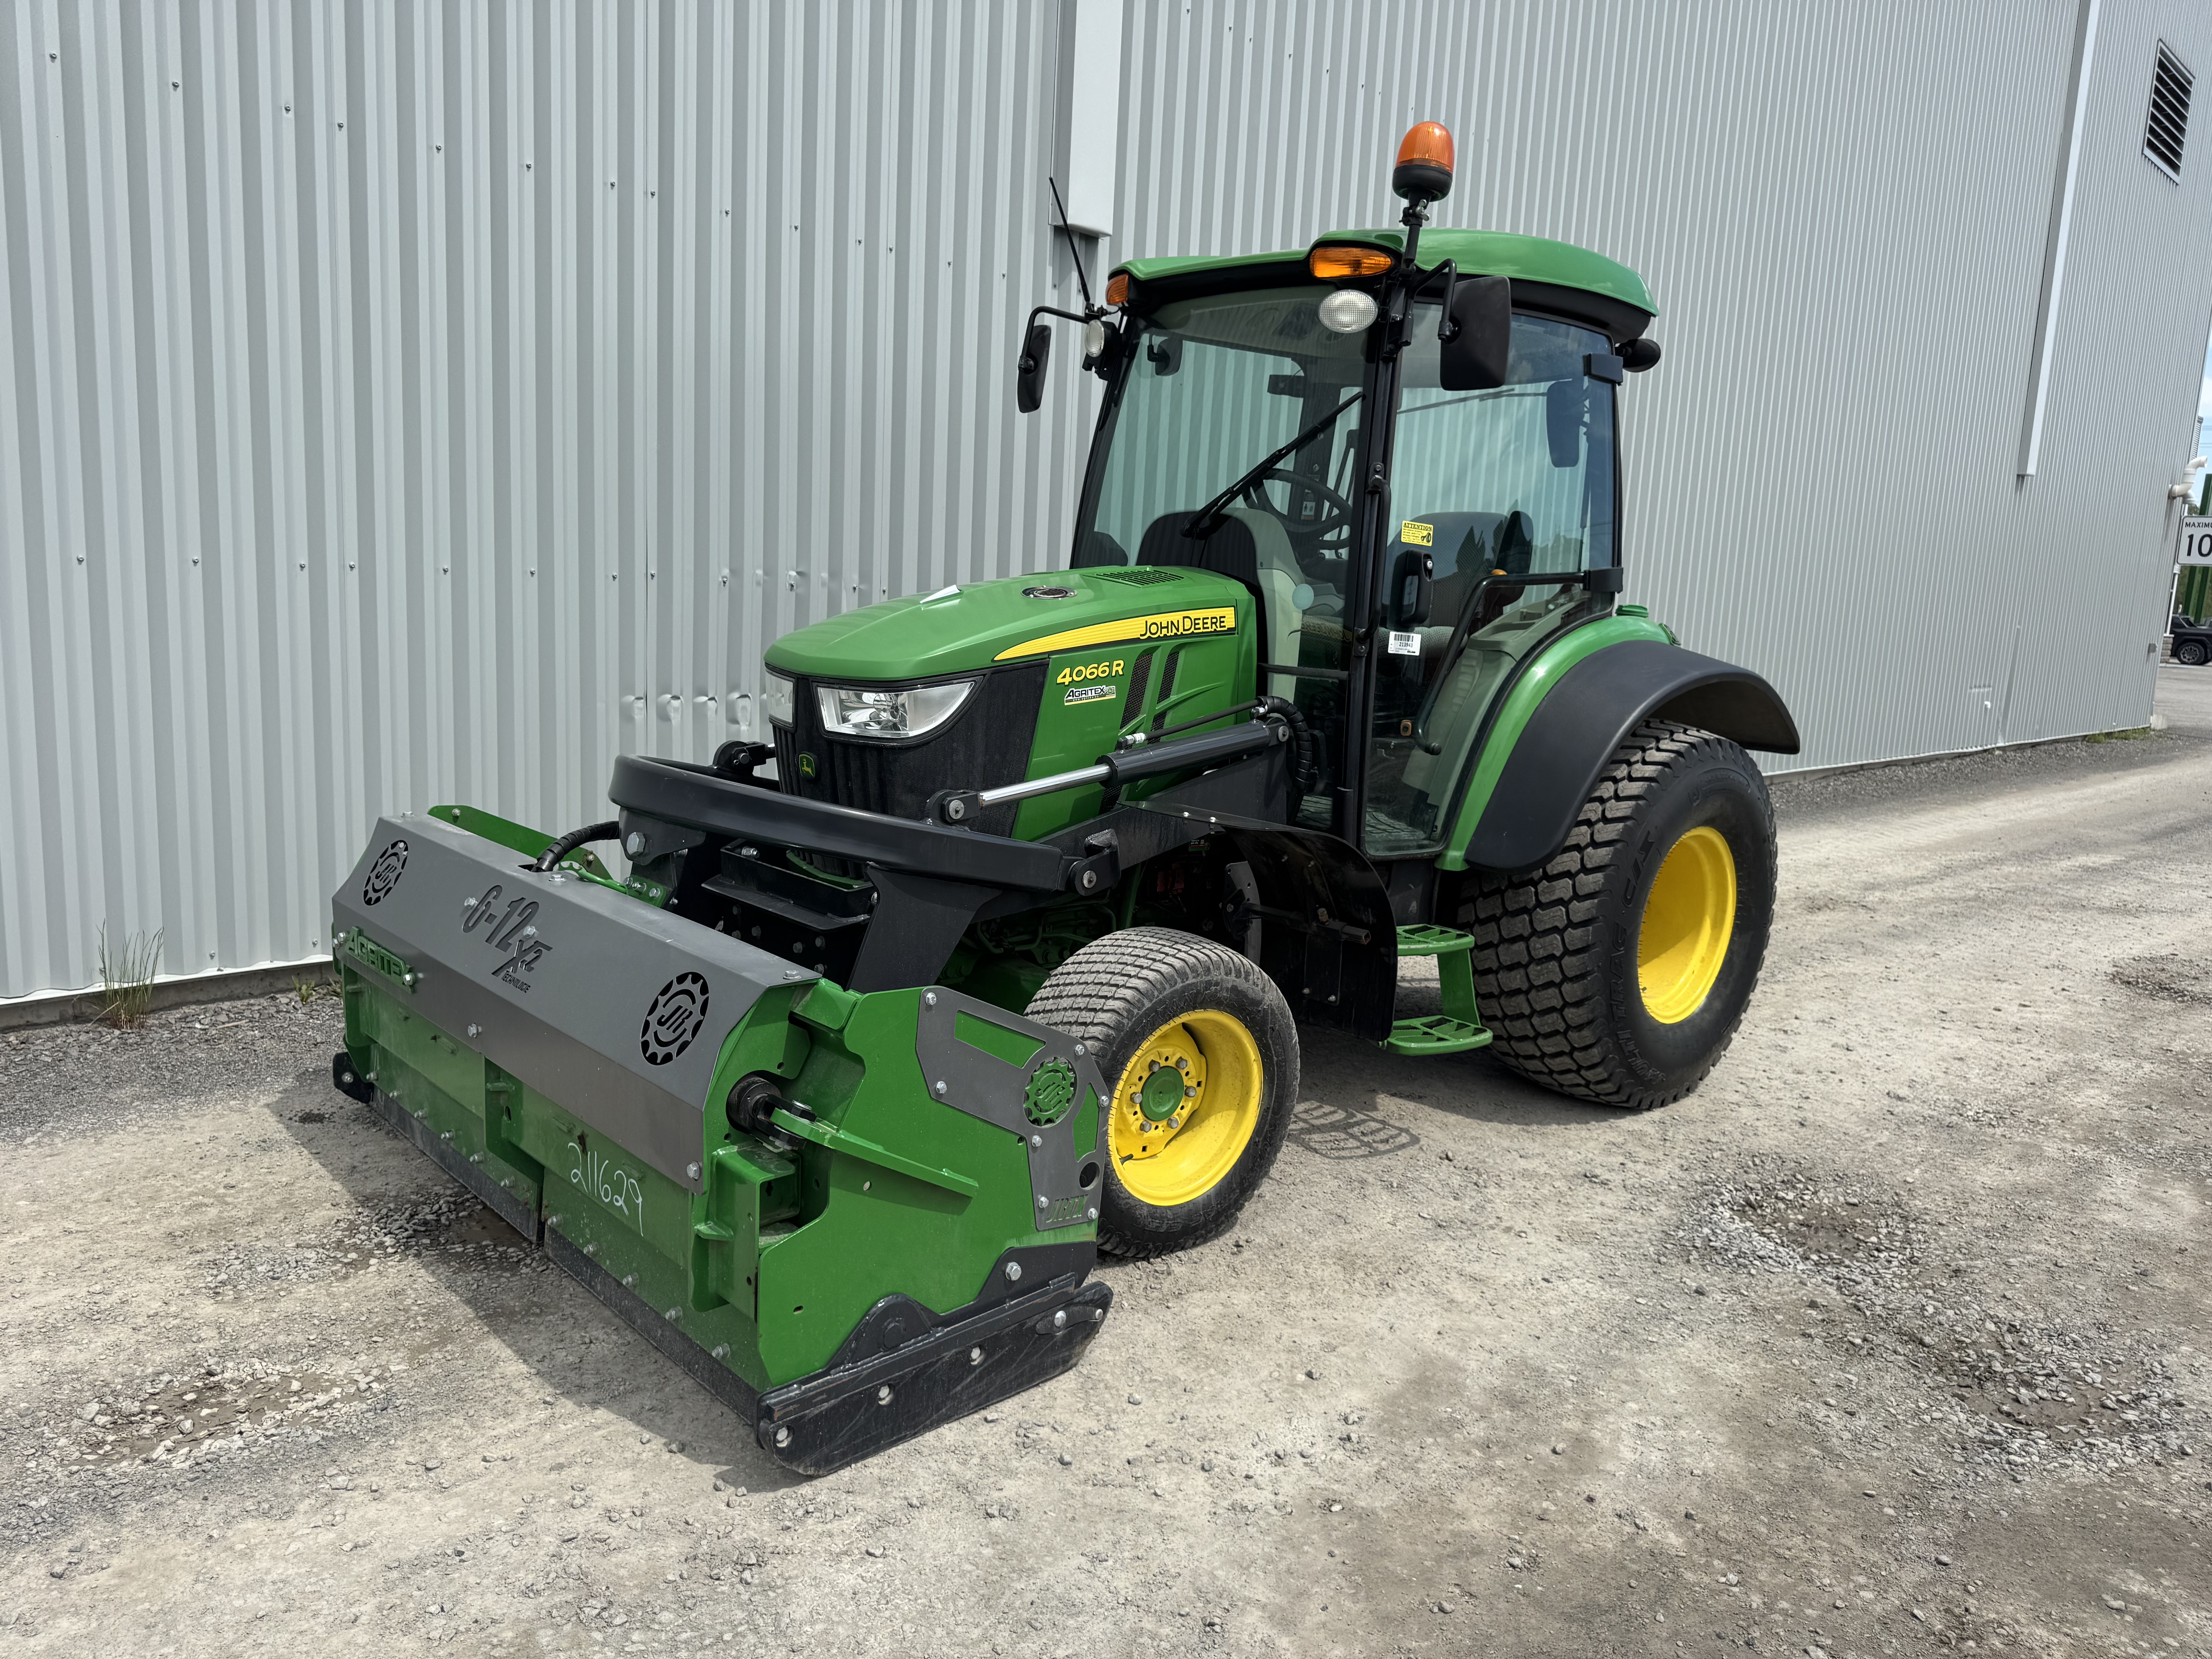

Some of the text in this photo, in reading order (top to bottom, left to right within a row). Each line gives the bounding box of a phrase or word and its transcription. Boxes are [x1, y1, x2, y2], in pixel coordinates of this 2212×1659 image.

[1403, 522, 1432, 531] ATTENTION
[2187, 534, 2212, 557] 10
[1140, 616, 1226, 637] JOHN DEERE
[1065, 687, 1105, 699] AGRITEX
[501, 970, 531, 993] TECHNOLOGIE
[568, 1142, 643, 1237] 211629
